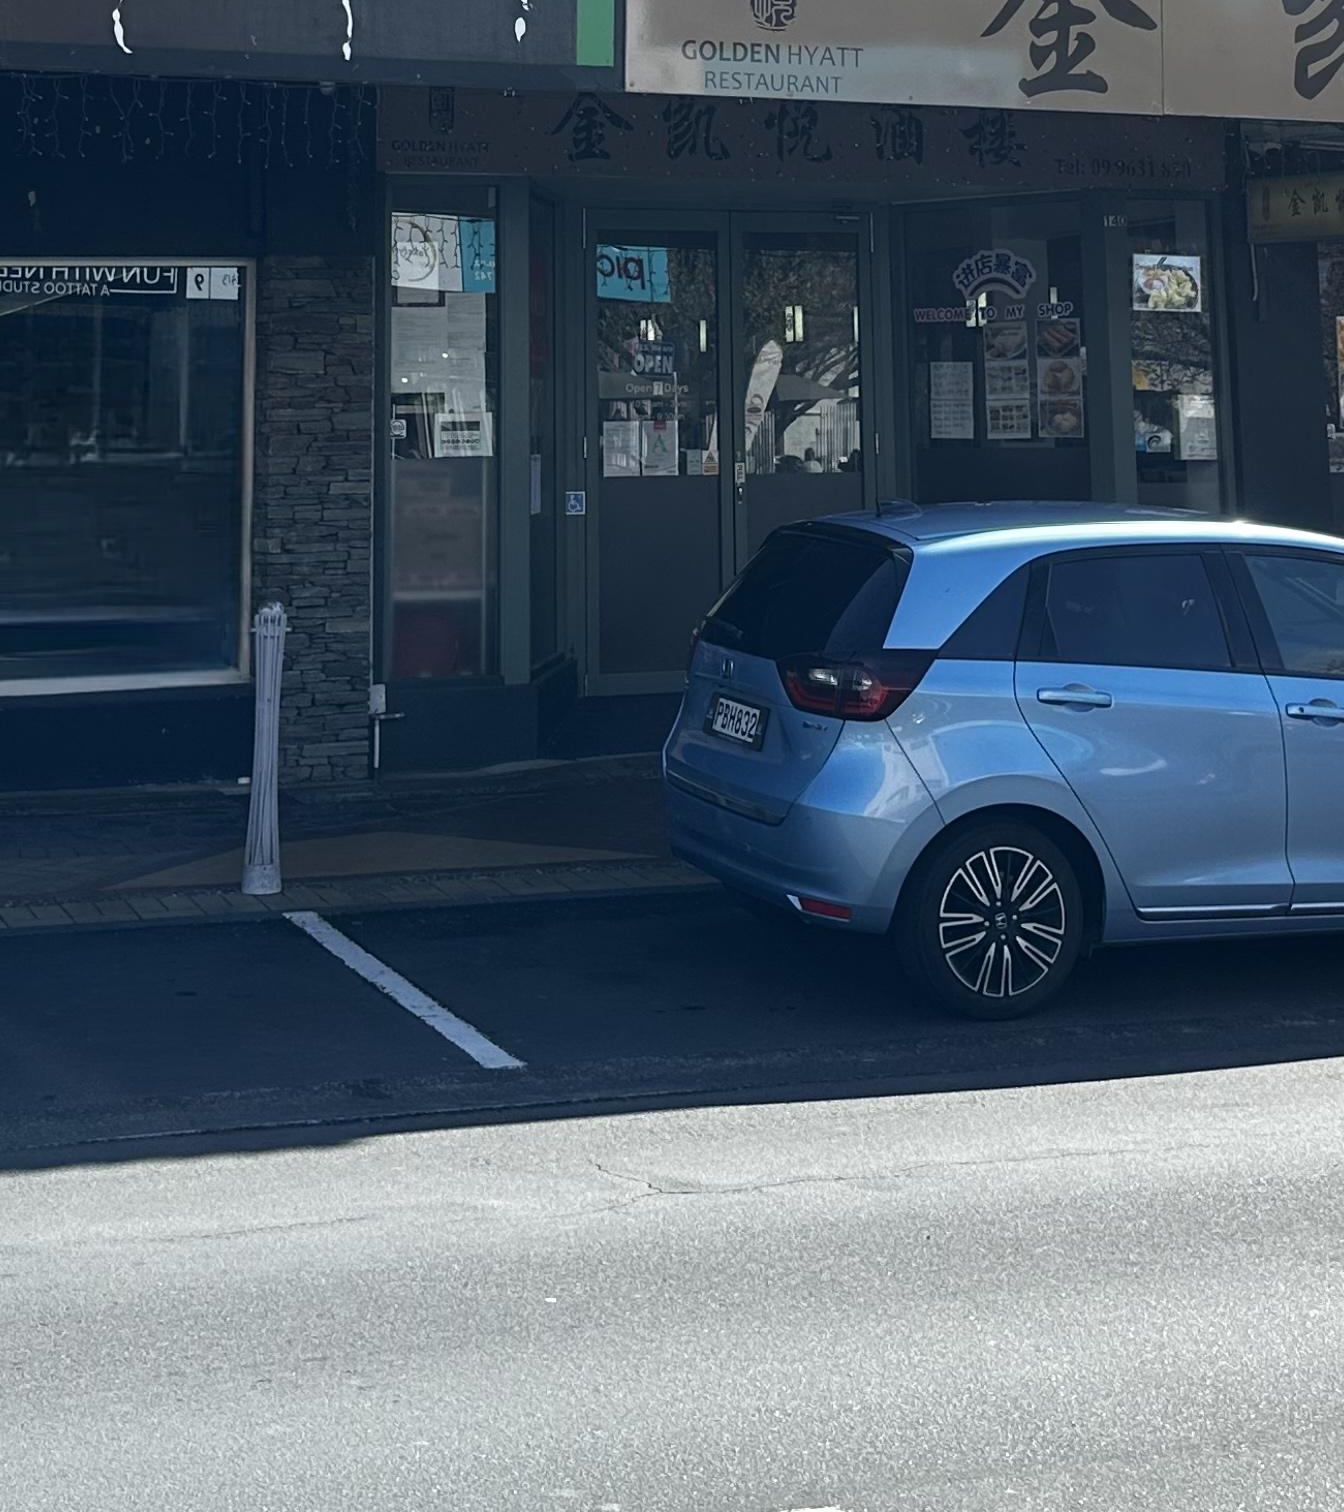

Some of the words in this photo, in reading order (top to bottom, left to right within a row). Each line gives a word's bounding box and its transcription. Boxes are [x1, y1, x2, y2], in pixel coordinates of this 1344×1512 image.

[681, 40, 780, 64] GOLDEN
[787, 44, 864, 68] HYATT
[704, 71, 842, 94] RESTAURANT
[1054, 158, 1086, 176] Tel:
[915, 307, 972, 321] WELCOME
[980, 308, 996, 319] TO
[1005, 306, 1024, 318] MY
[1039, 304, 1073, 316] SHOP
[634, 353, 674, 375] OPEN
[625, 383, 653, 394] Open
[714, 702, 758, 738] PBH832
